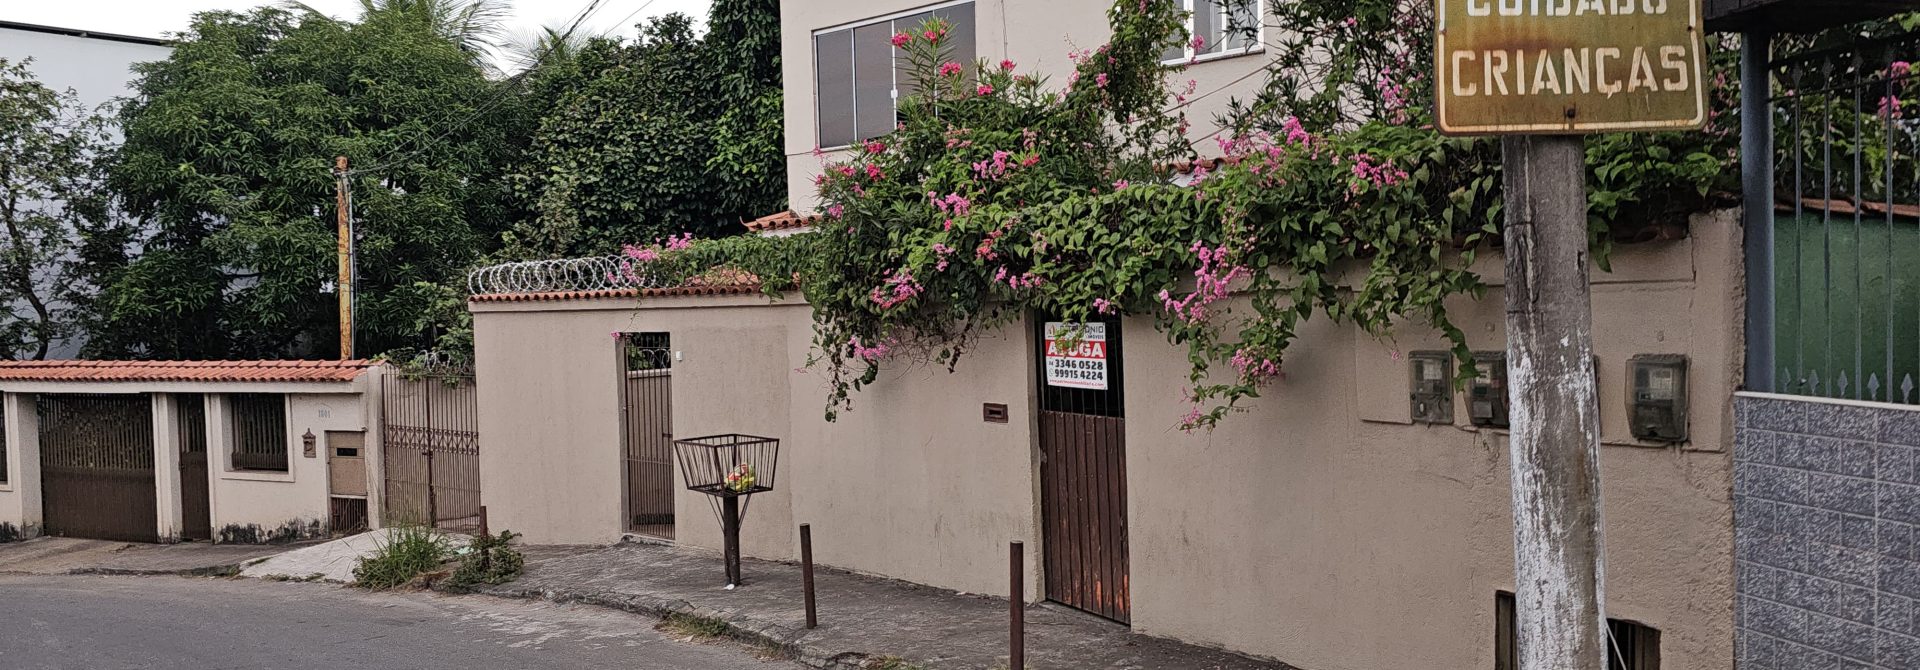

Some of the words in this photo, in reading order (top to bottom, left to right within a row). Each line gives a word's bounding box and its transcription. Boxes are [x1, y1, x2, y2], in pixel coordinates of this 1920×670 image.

[1452, 45, 1688, 99] CRIANÇAS
[1055, 359, 1076, 368] 3346
[1079, 360, 1103, 370] 0528
[1055, 369, 1078, 378] 99915
[1080, 370, 1103, 380] 4224
